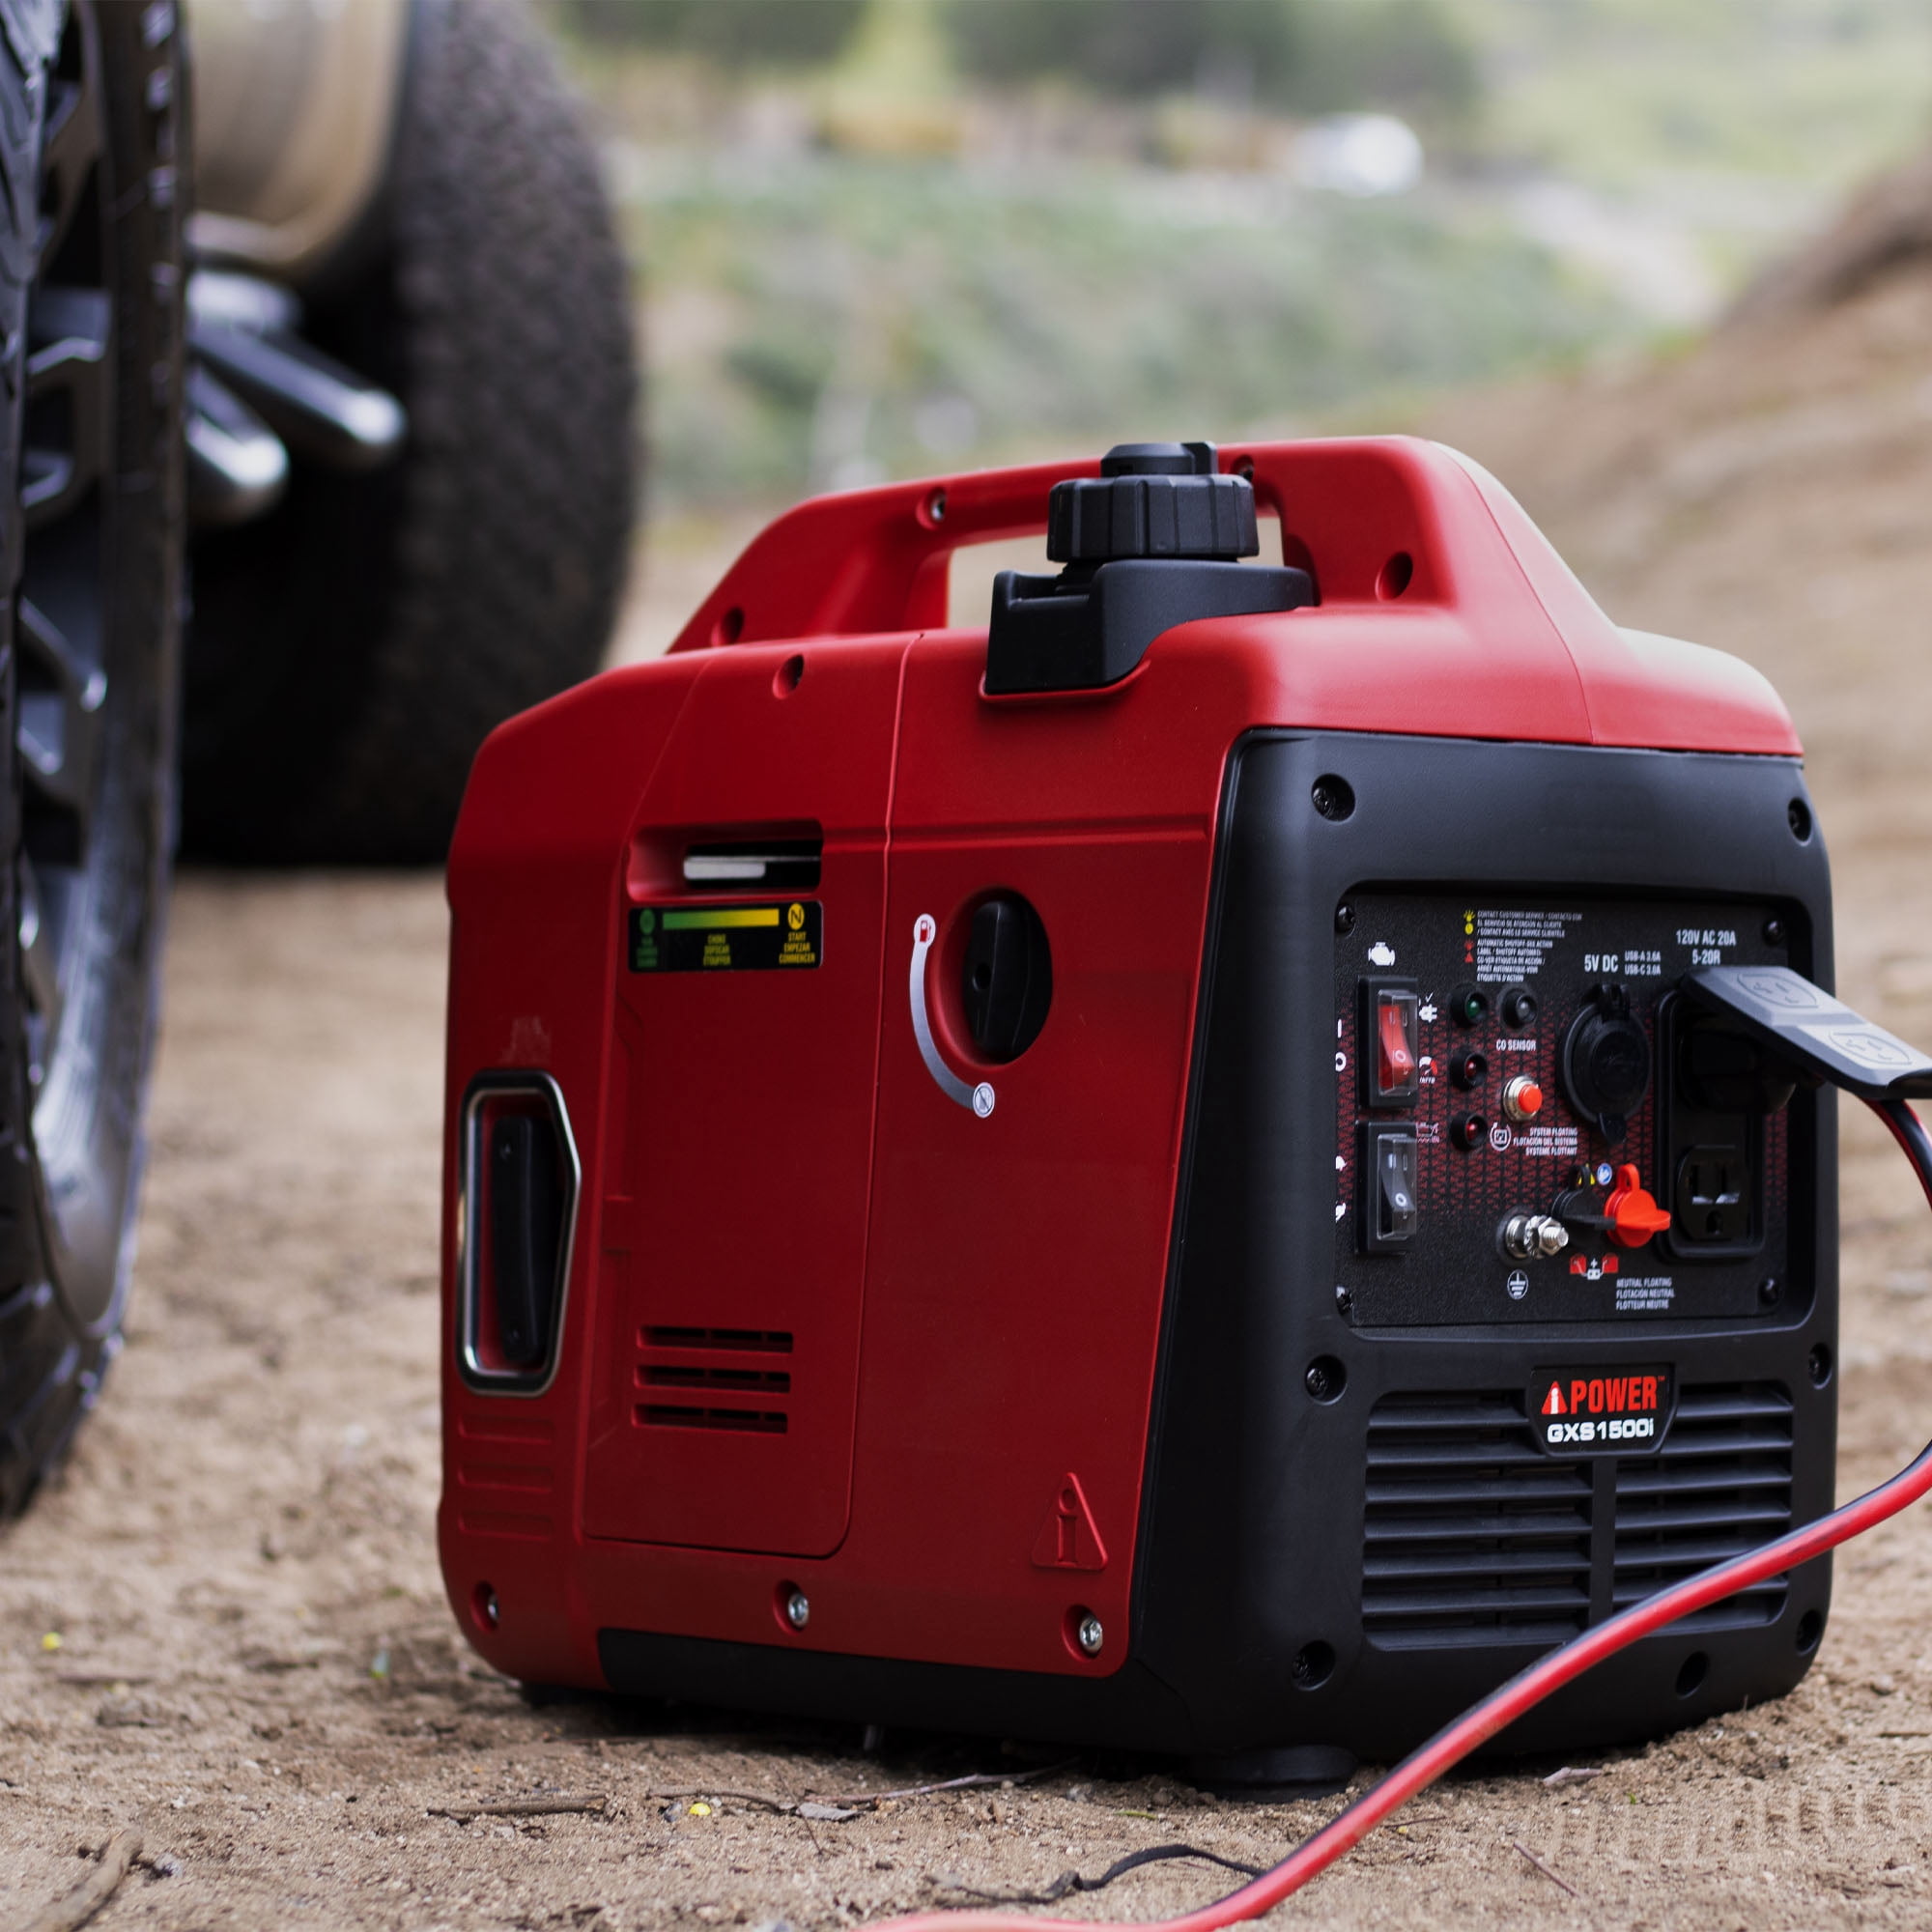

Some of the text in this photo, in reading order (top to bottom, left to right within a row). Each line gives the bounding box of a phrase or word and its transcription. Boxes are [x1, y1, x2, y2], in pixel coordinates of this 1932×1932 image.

[1676, 929, 1737, 946] 120V AC 20A
[1625, 951, 1645, 961] USB-A
[1692, 949, 1720, 965] 5-20R
[1584, 954, 1618, 972] 5V DC
[1625, 964, 1645, 976] USB-C
[1496, 1038, 1536, 1051] CO SENSOR
[1530, 1127, 1577, 1136] SYSTEM FLOATING
[1616, 1277, 1672, 1288] NEUTRAL FLOATING
[1649, 1288, 1675, 1298] NEUTRAL
[1570, 1376, 1658, 1414] POWER
[1547, 1418, 1654, 1443] GXS1500i
